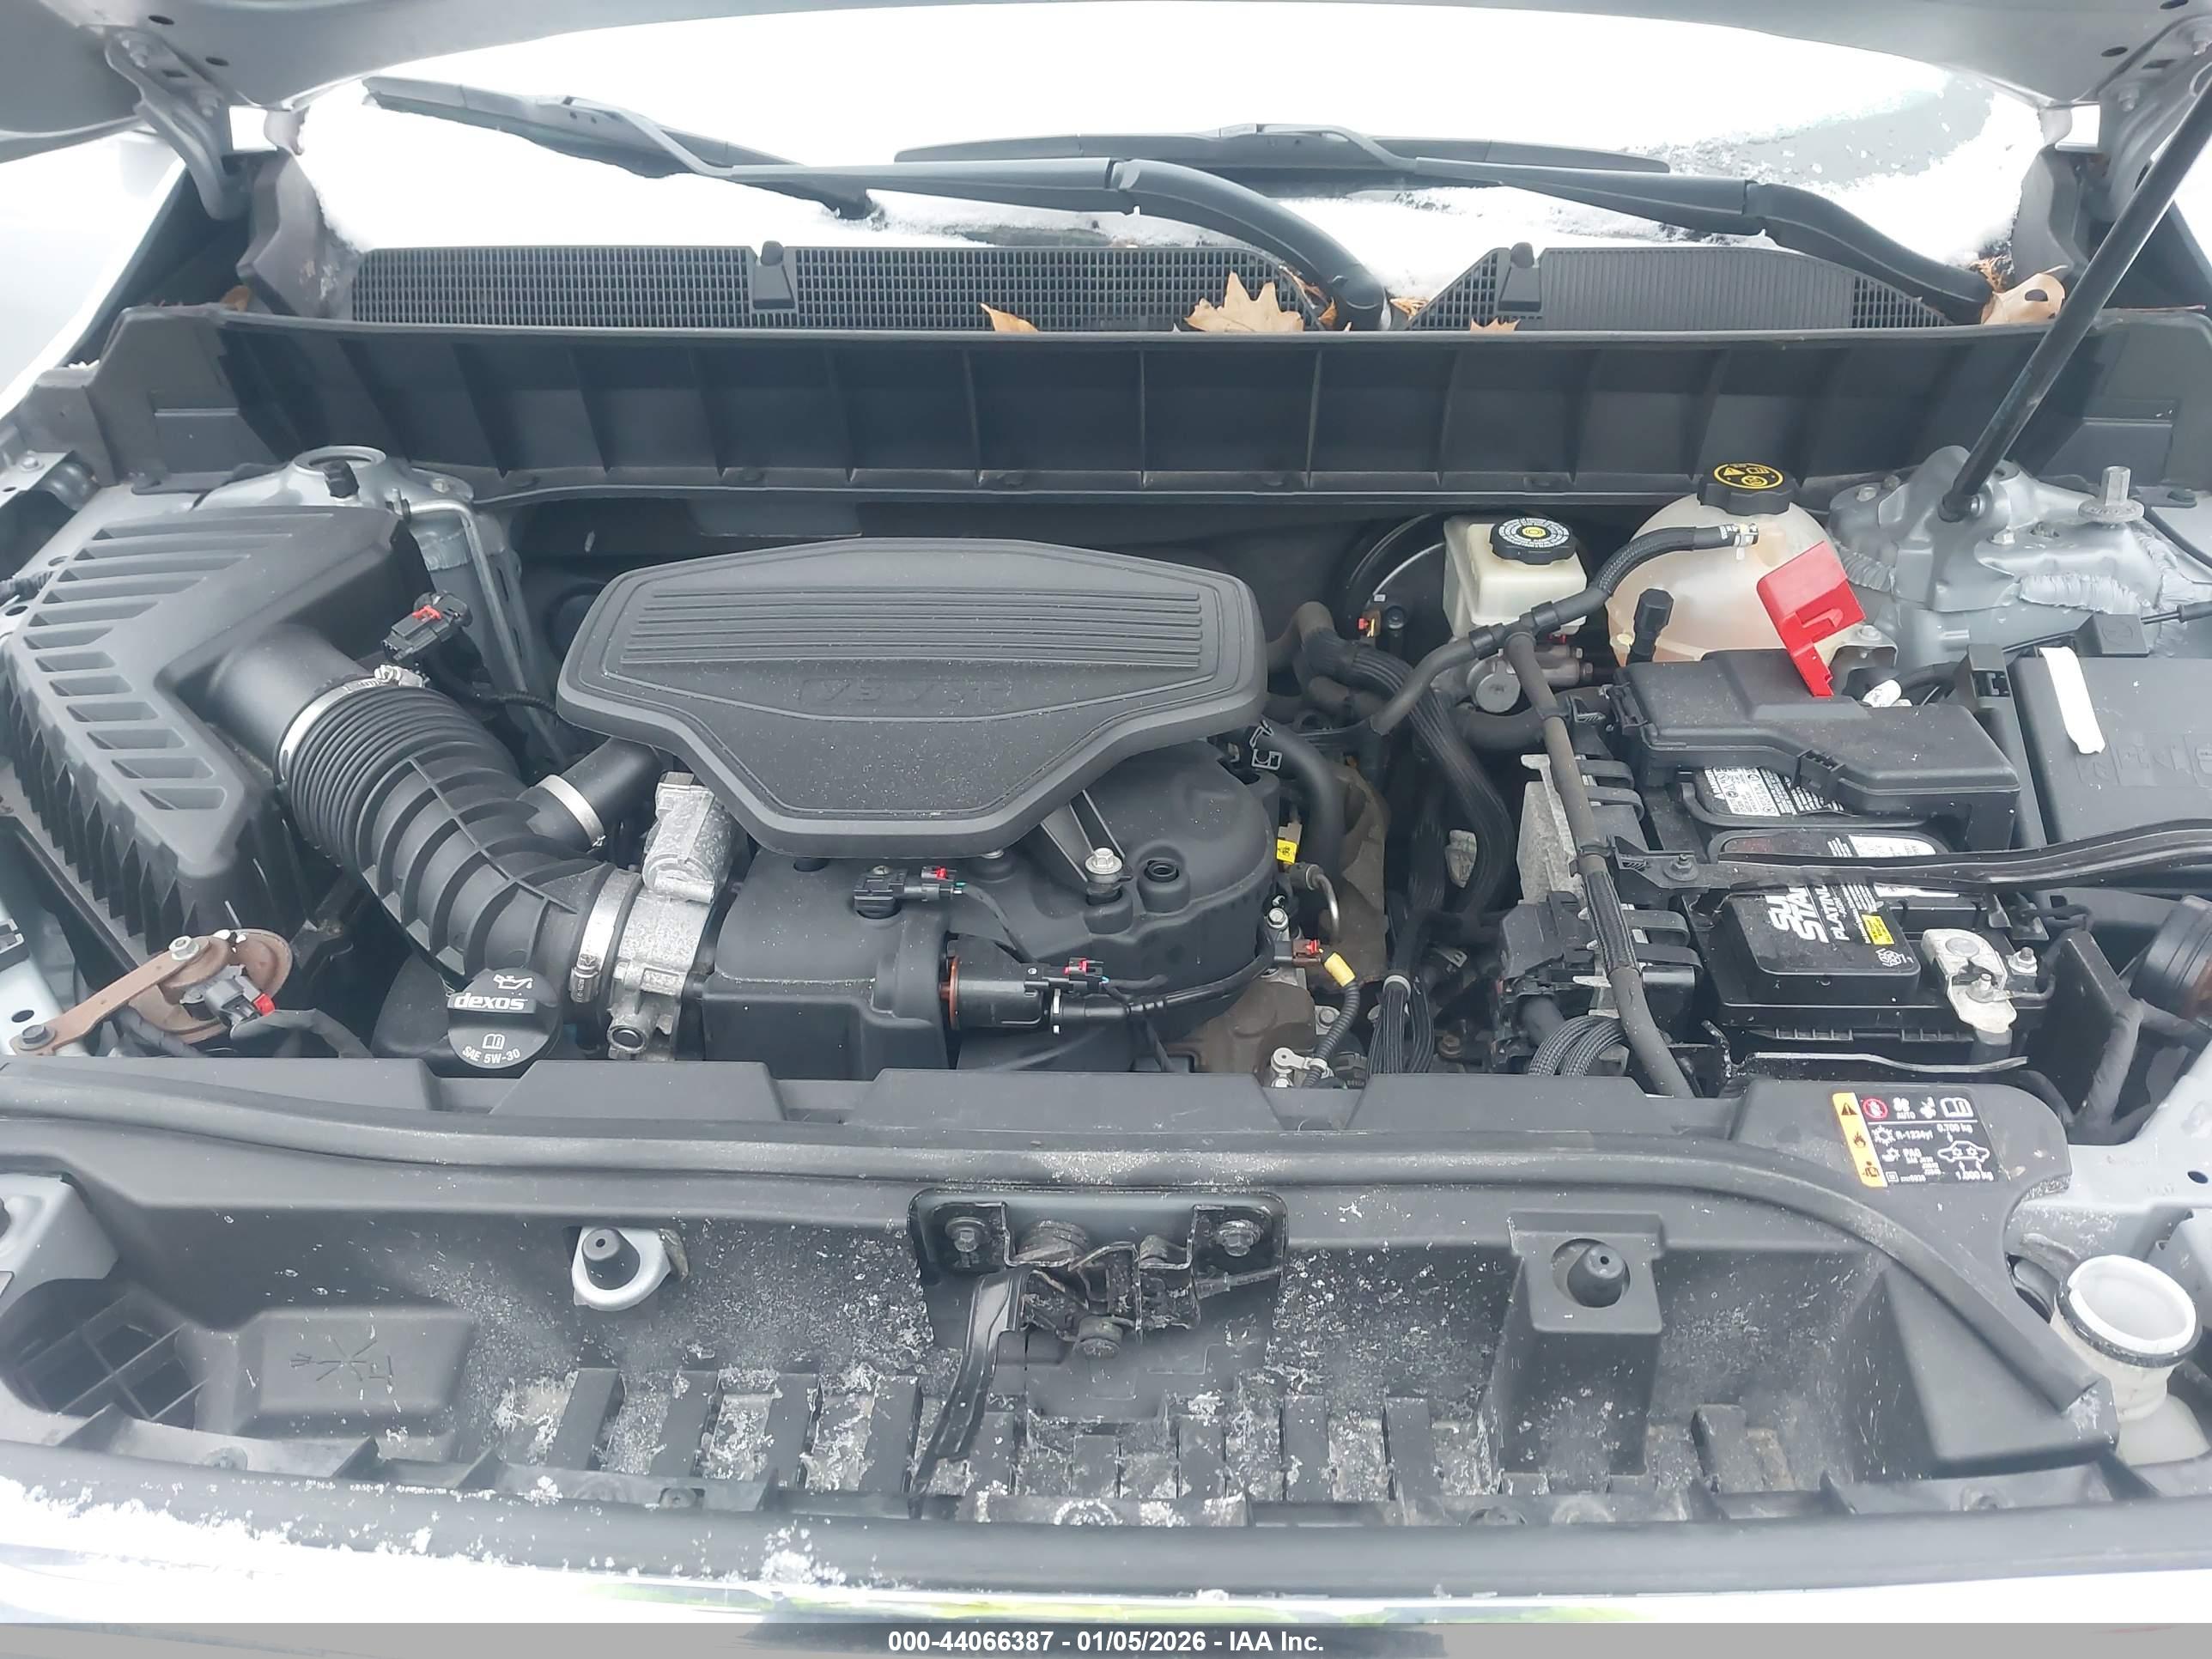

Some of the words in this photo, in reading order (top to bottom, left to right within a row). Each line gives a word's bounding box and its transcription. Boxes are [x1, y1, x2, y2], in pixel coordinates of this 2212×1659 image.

[454, 993, 526, 1011] dexos
[462, 1046, 482, 1062] SAE
[483, 1048, 520, 1064] 5W-30
